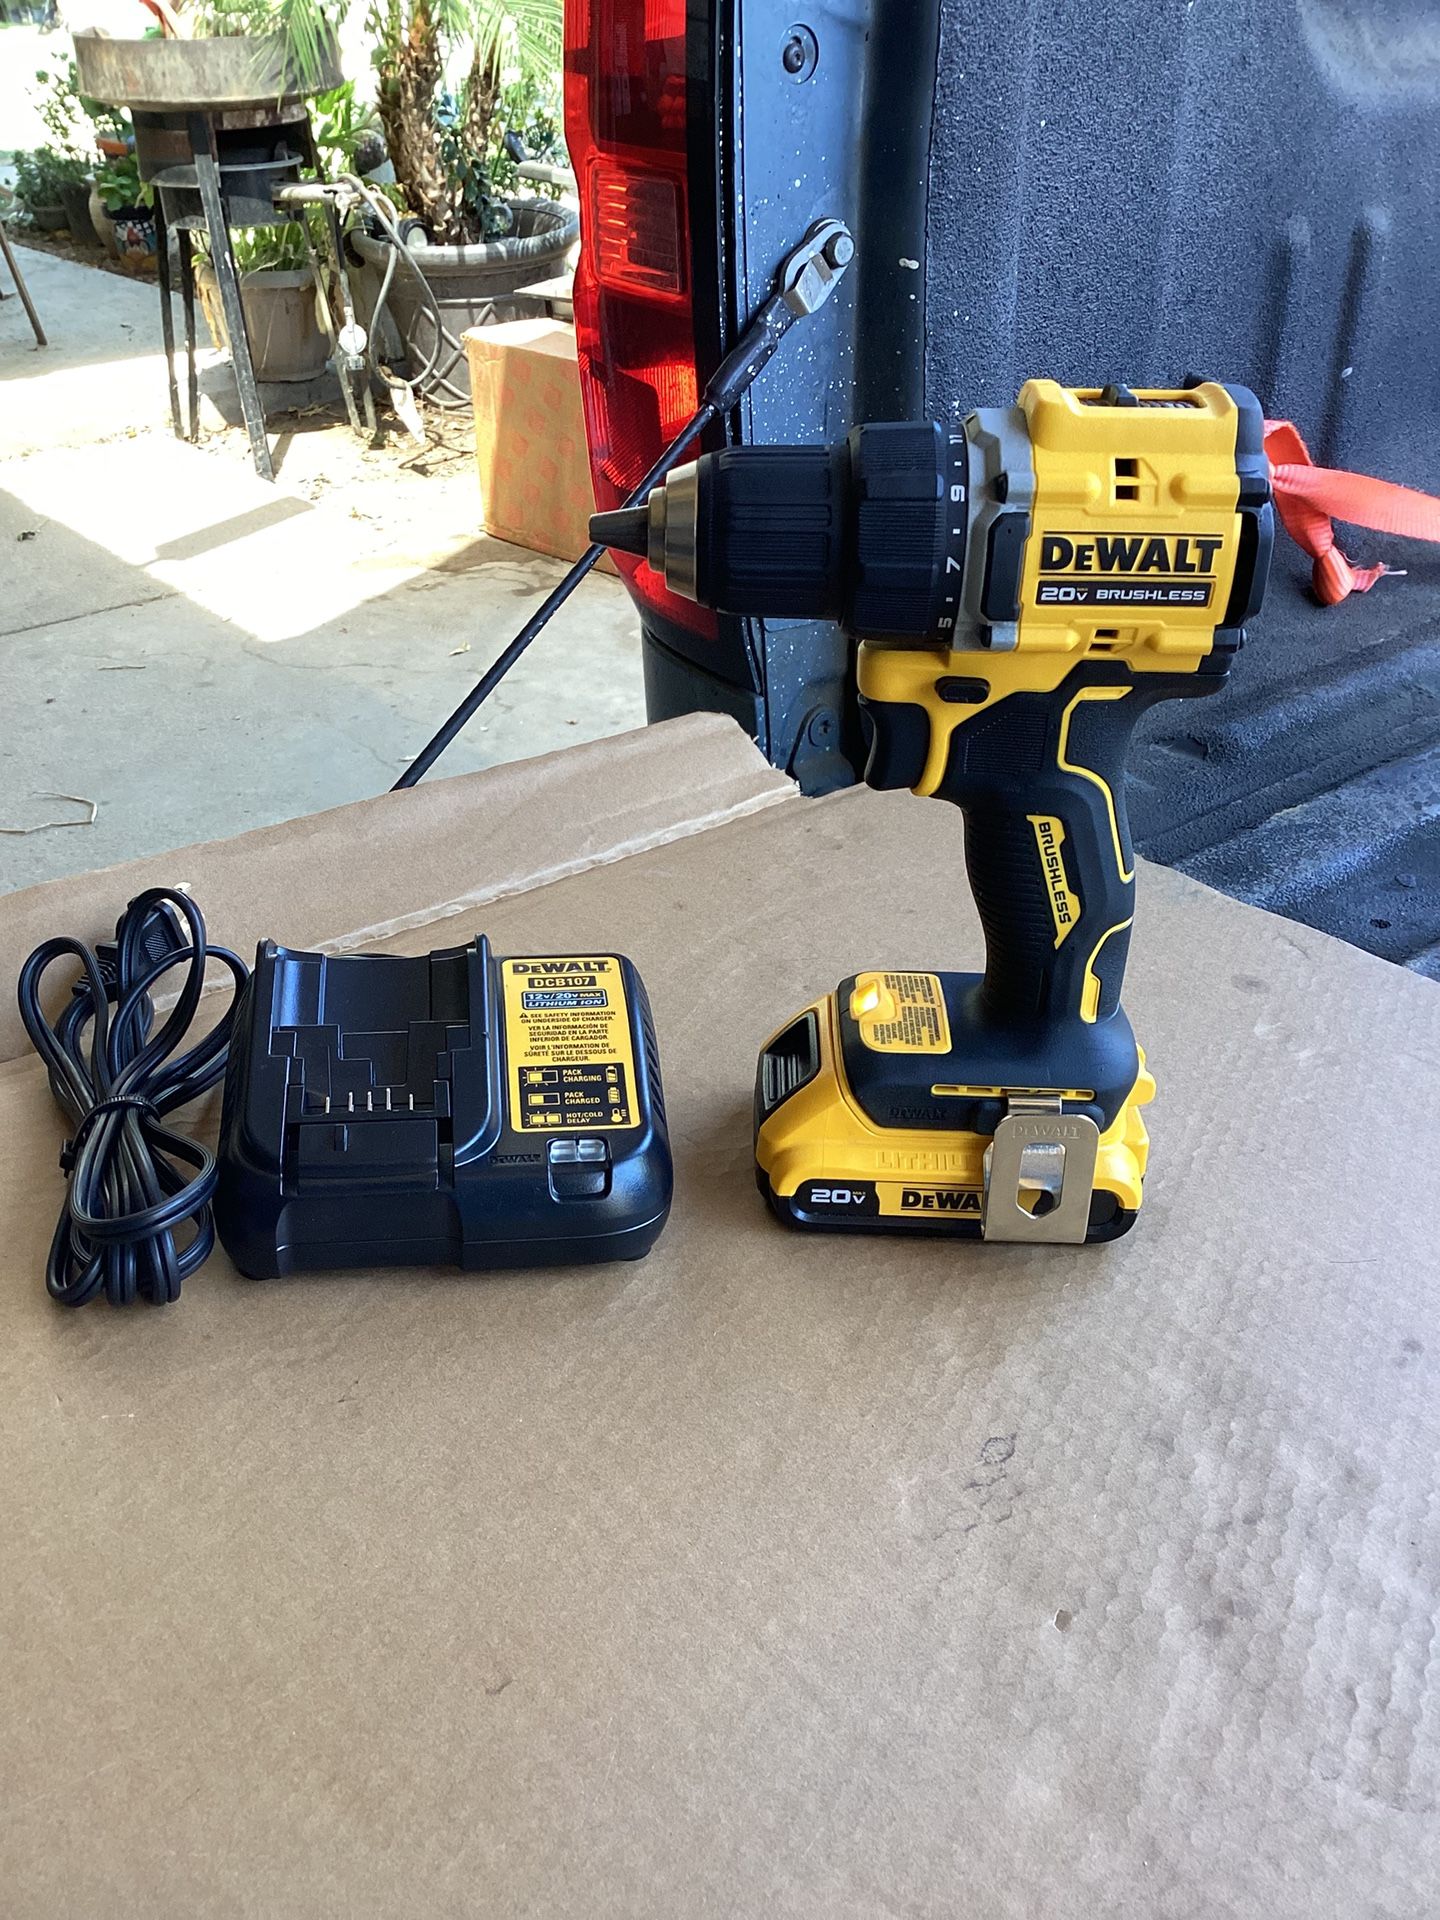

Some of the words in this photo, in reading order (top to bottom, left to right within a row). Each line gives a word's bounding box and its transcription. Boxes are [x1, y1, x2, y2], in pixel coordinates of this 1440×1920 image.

[950, 485, 965, 502] 9
[1040, 537, 1223, 573] DEWALT
[946, 557, 961, 573] 7
[1096, 589, 1206, 601] BRUSHLESS
[937, 617, 953, 628] 5
[1039, 822, 1071, 923] BRUSHLESS
[513, 961, 608, 973] DEWALT
[534, 977, 590, 987] DCB107
[552, 1022, 599, 1030] INFORMACIÓN
[564, 1097, 600, 1105] CHARGED
